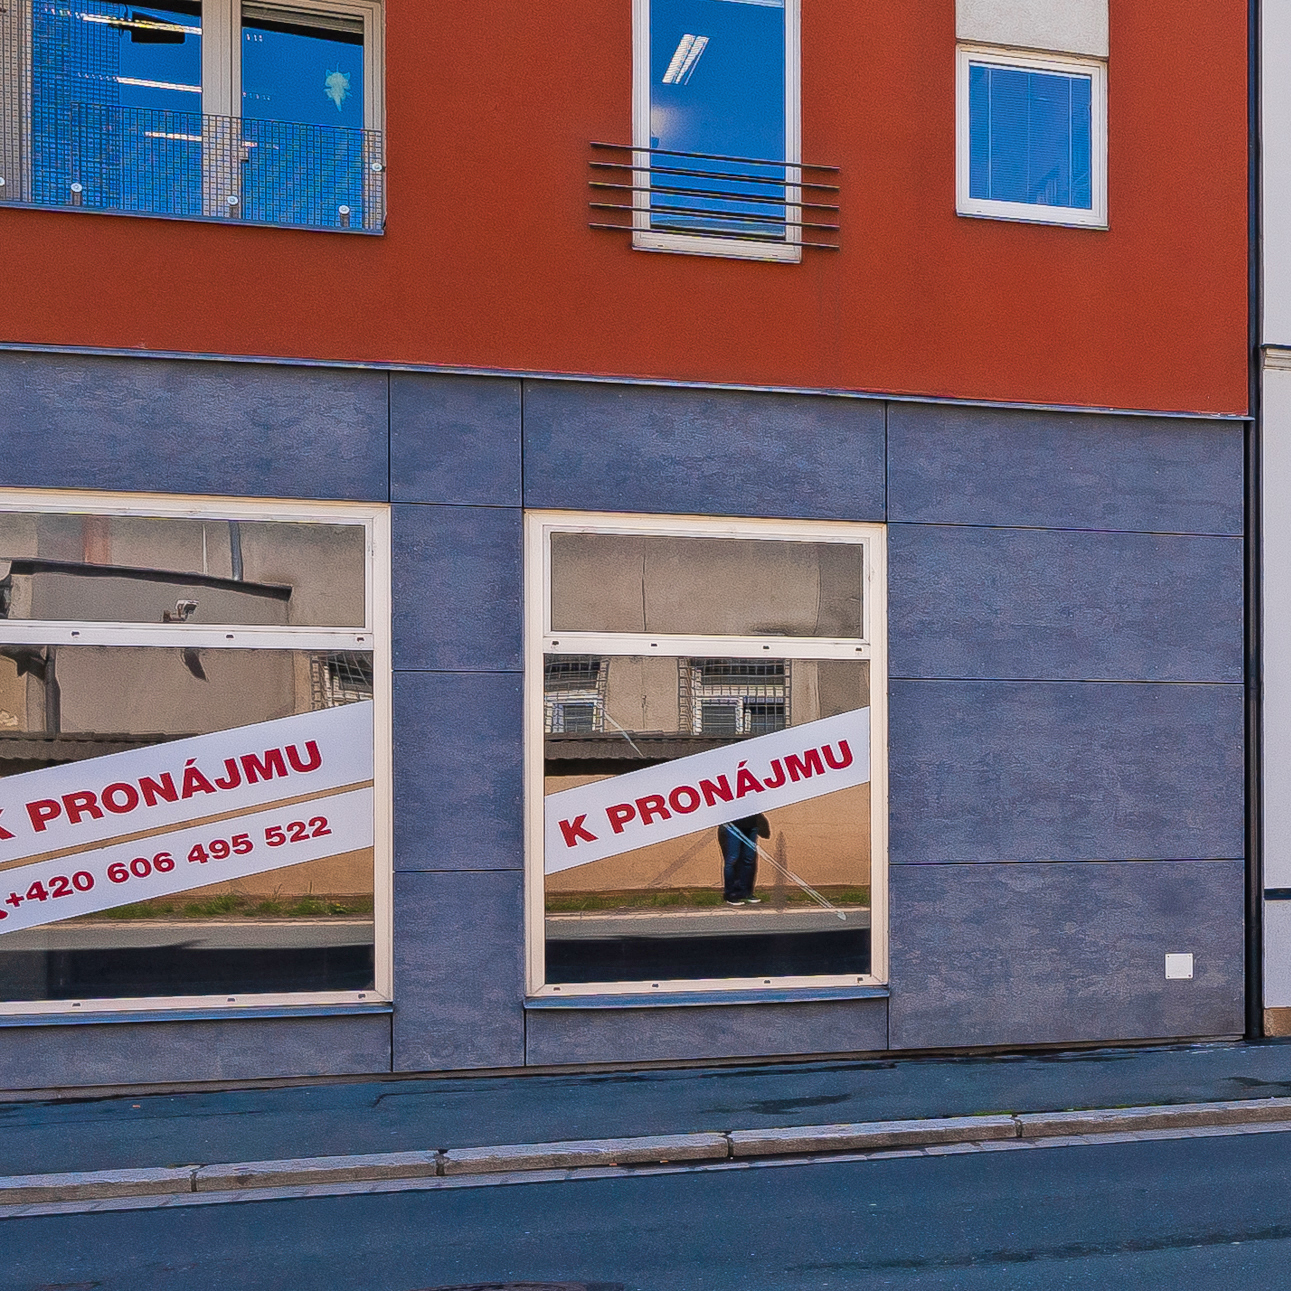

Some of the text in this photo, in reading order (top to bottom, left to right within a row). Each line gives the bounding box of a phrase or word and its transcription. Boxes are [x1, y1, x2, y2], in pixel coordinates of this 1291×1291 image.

[25, 740, 323, 833] PRONÁJMU
[558, 739, 854, 848] K PRONÁJMU
[6, 816, 332, 907] +420 606 495 522
